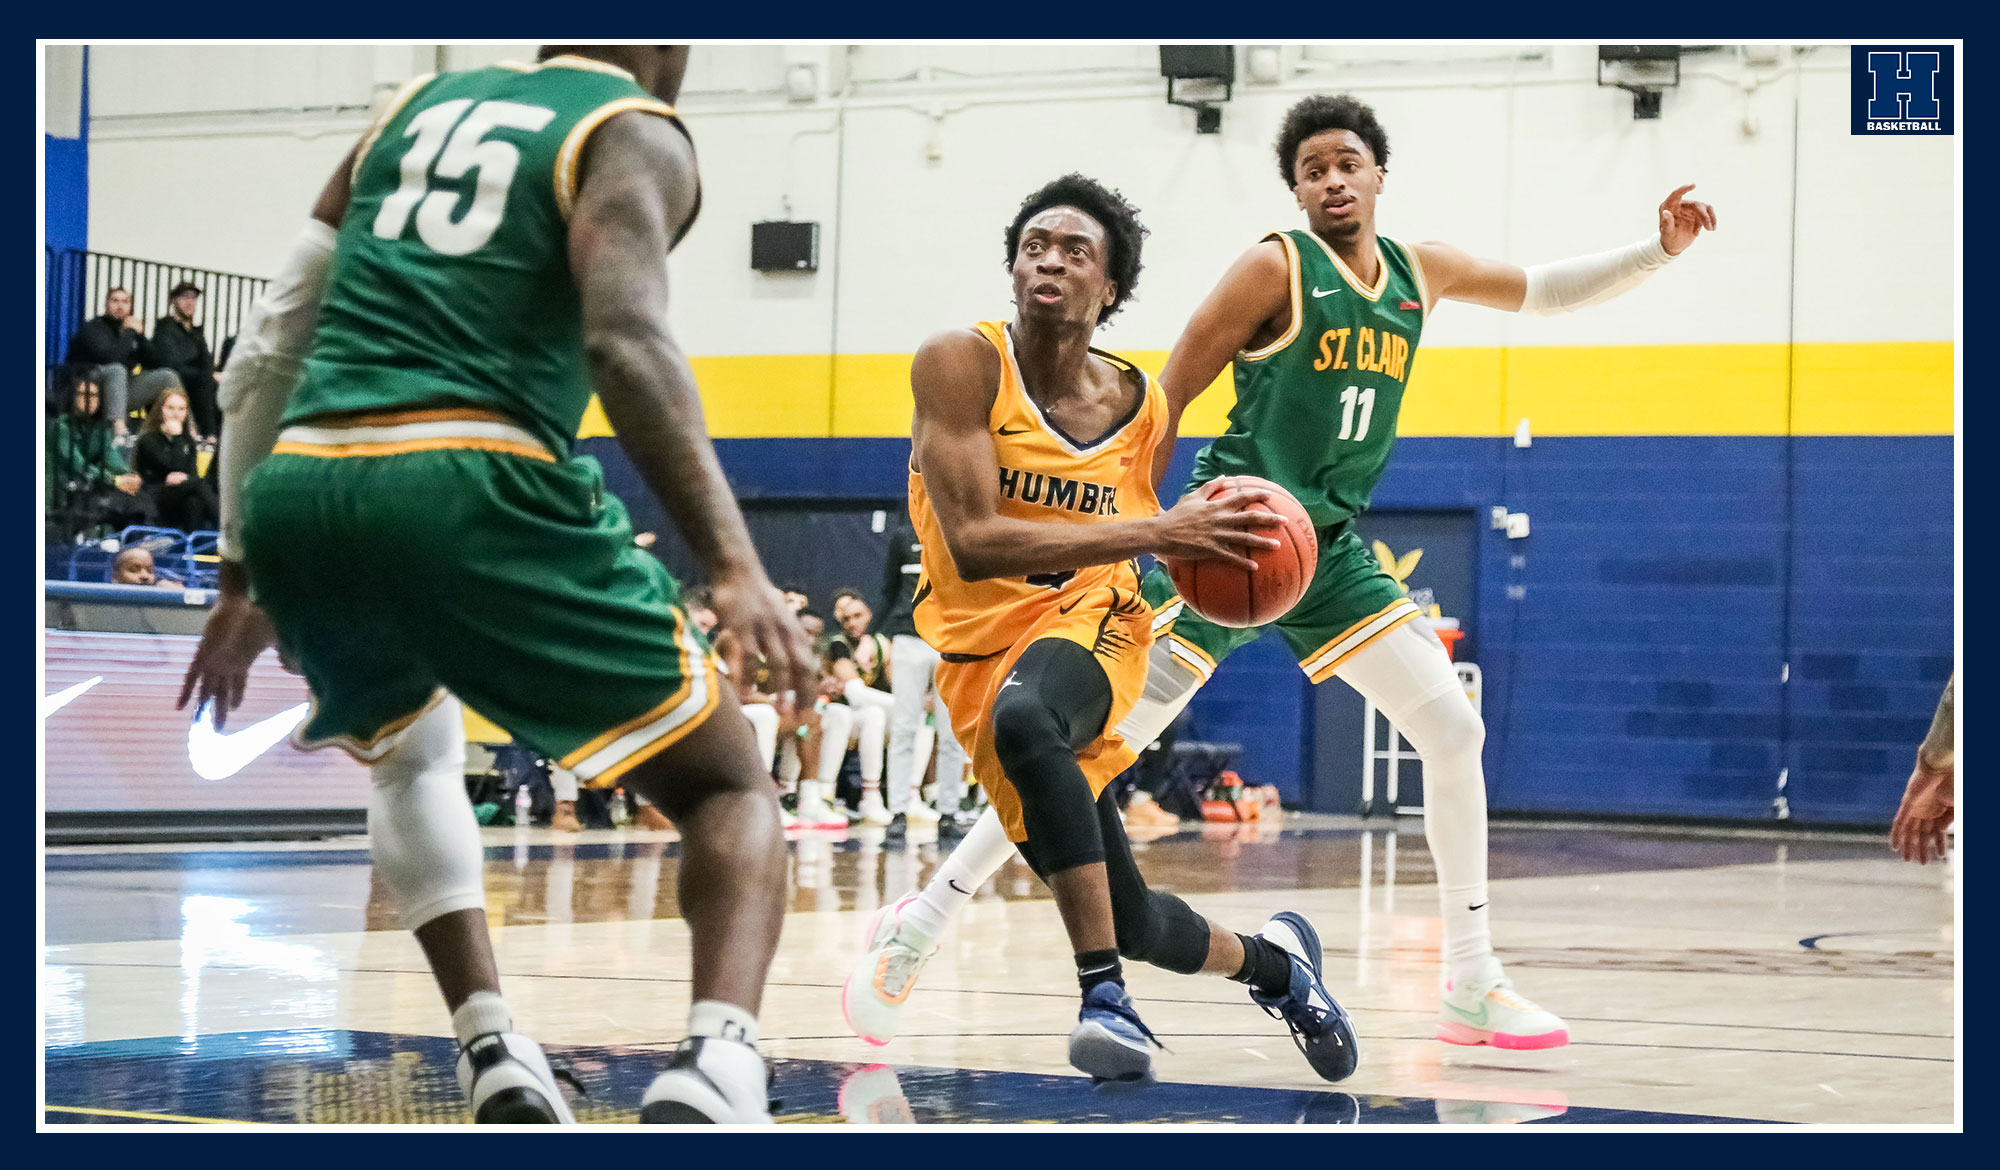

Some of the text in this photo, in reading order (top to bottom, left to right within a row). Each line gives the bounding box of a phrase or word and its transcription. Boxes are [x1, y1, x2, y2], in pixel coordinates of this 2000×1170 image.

[373, 98, 556, 257] 15
[1313, 326, 1409, 383] ST. CLAIR
[1337, 385, 1376, 442] 11
